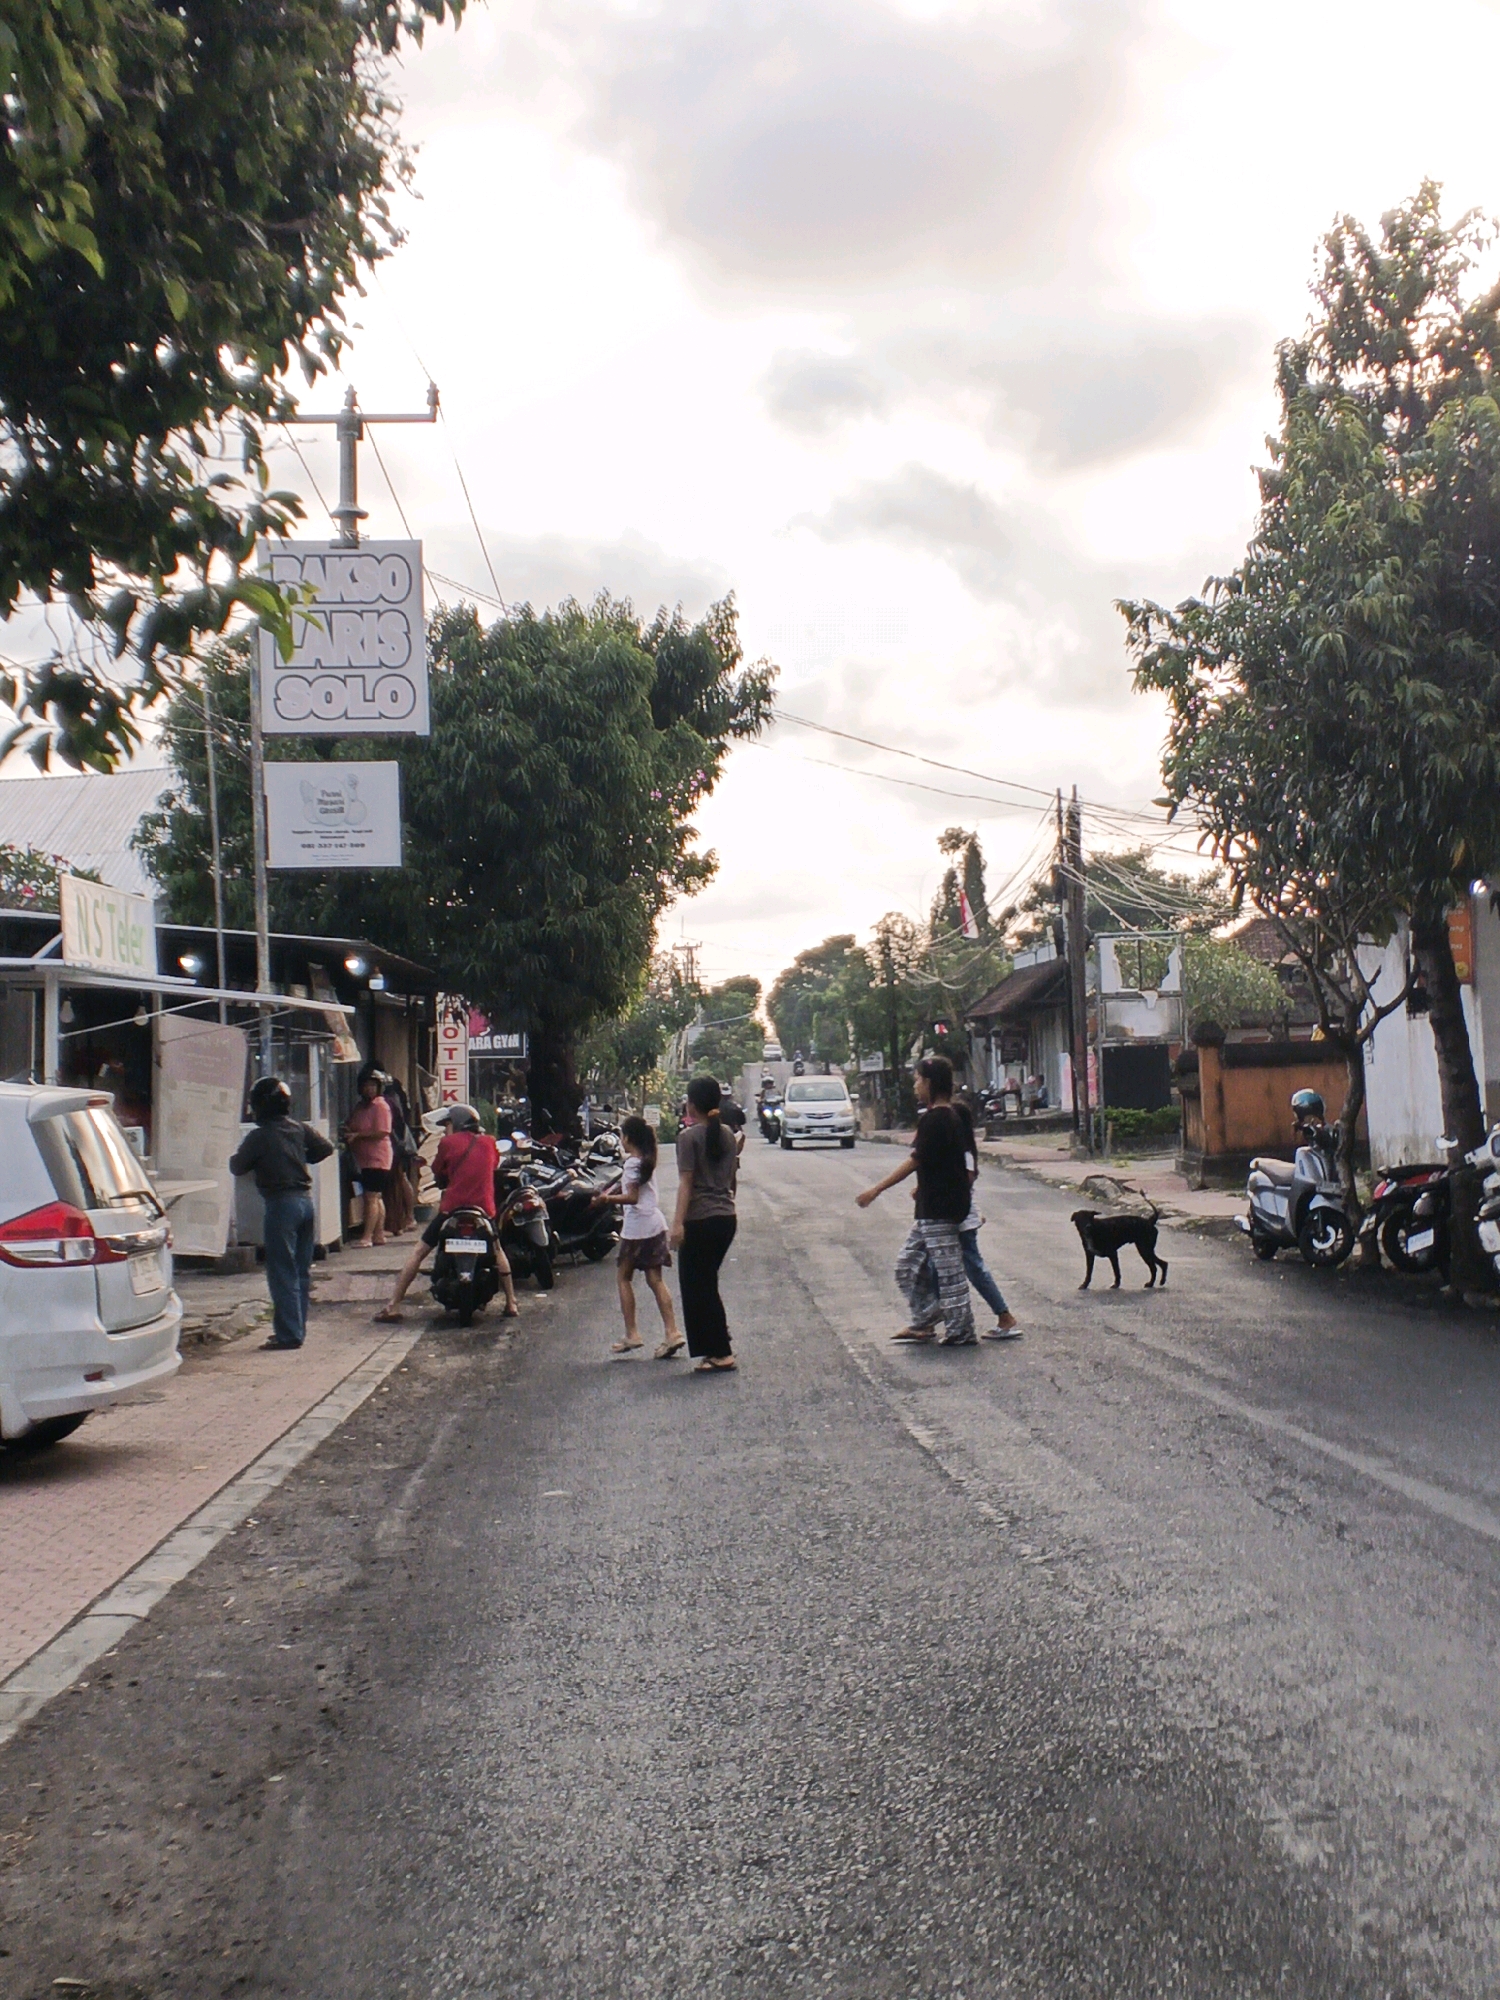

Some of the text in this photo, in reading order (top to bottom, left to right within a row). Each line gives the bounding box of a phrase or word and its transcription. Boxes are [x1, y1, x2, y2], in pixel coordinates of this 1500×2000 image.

[270, 554, 412, 604] BAKSO
[273, 673, 417, 721] SOLO
[442, 1004, 459, 1102] OTEK
[469, 1033, 519, 1050] ARA GYM
